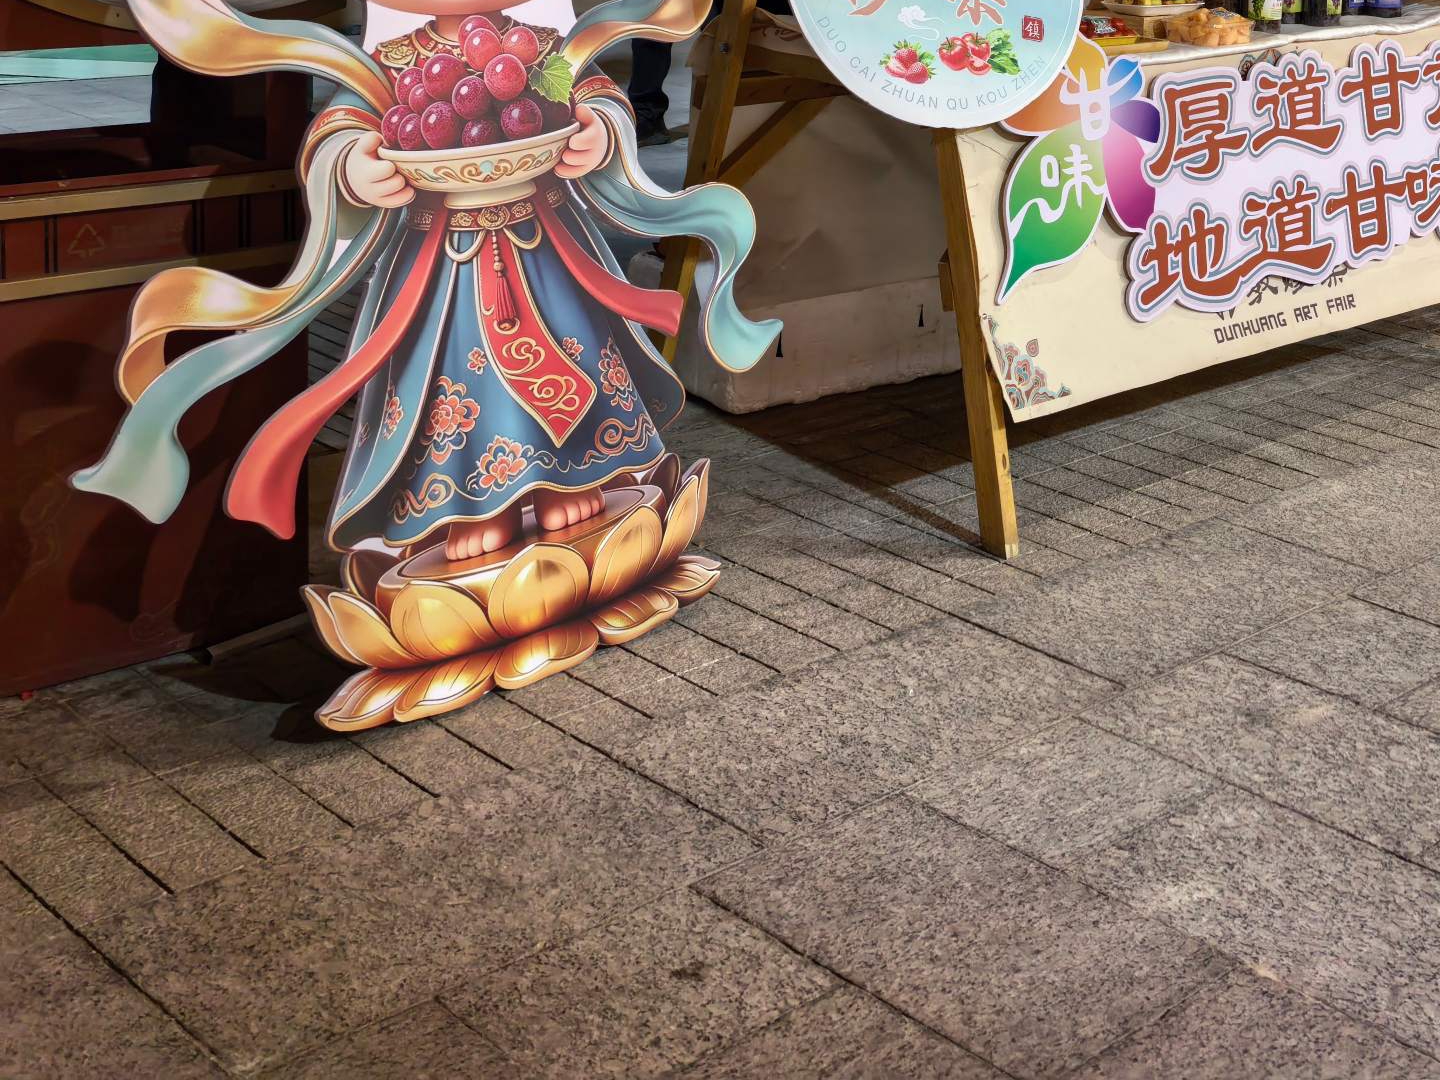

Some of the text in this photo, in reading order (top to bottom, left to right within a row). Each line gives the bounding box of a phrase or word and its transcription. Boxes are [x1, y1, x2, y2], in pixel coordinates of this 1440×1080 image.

[817, 15, 1047, 111] DUO CAI ZHUAN QU KOU ZHEN
[1214, 294, 1356, 344] DUNHUANG ART FAIR
